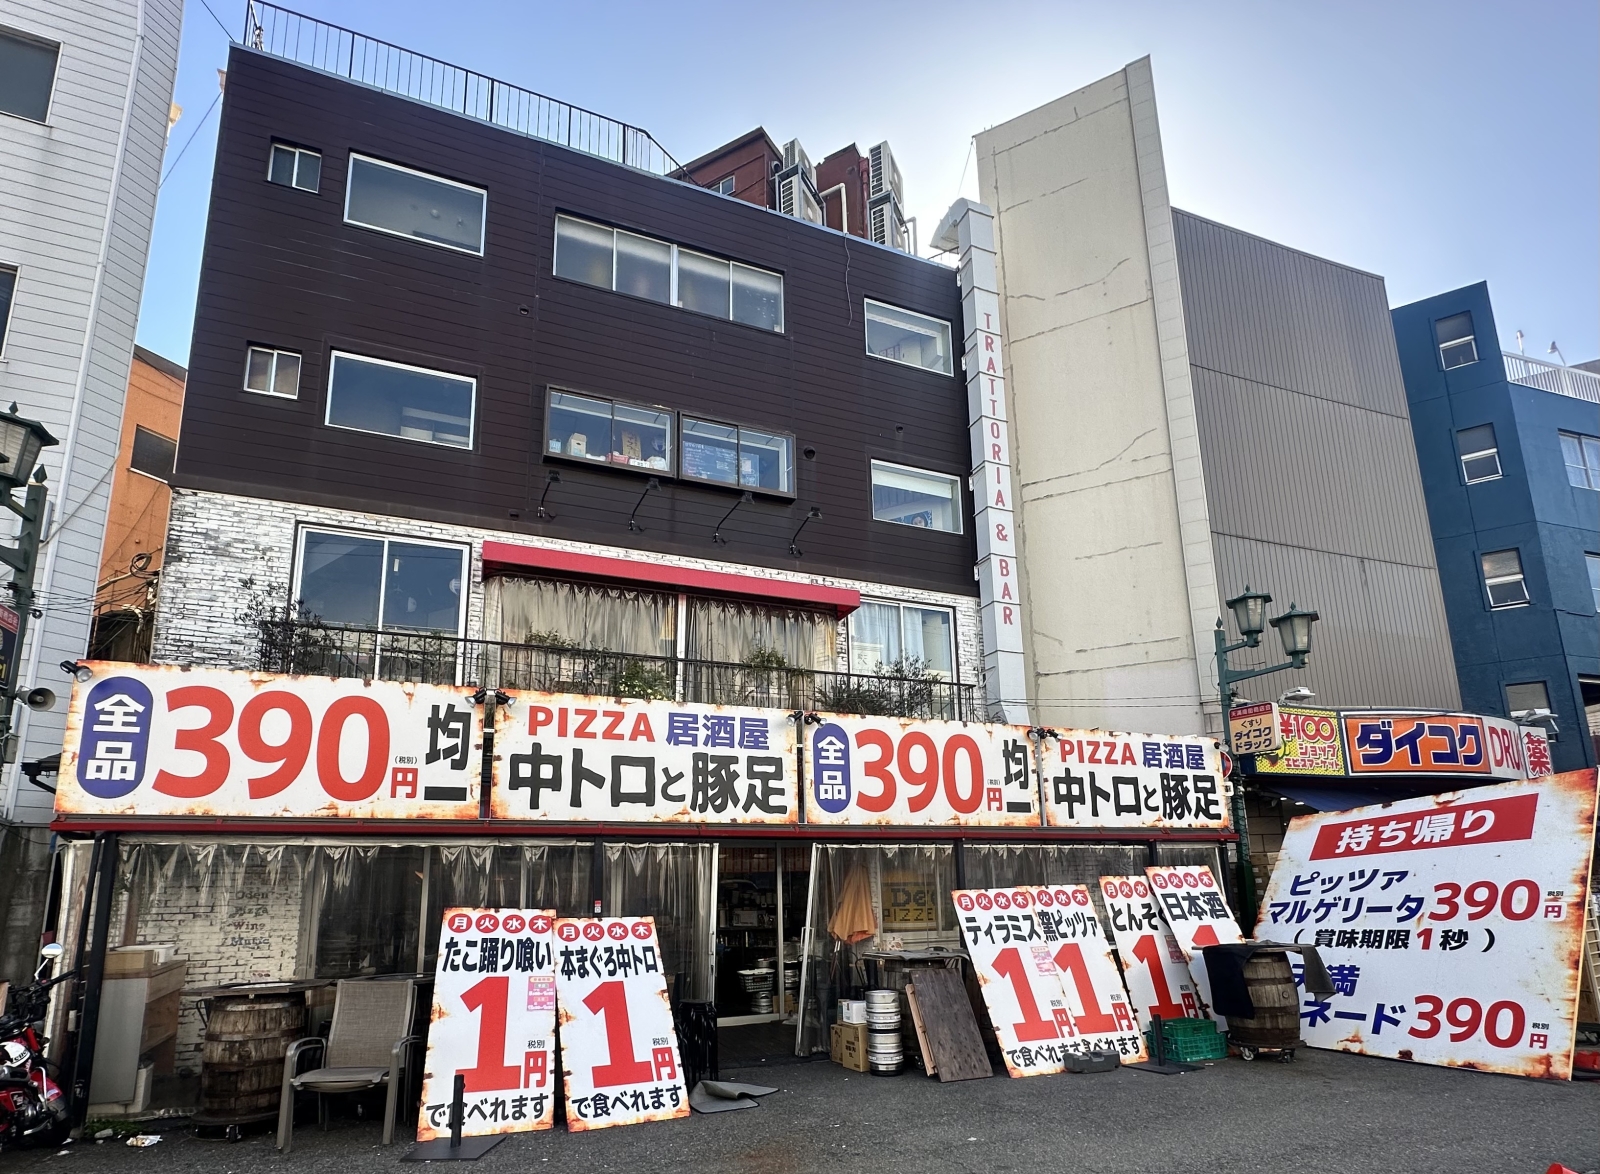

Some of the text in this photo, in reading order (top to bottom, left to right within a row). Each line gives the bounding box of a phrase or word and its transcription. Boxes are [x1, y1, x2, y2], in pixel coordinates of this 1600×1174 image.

[984, 313, 1013, 626] TRATTORIA & BAR
[86, 694, 146, 781] 全品
[528, 705, 770, 751] PIZZA 居酒屋
[1234, 727, 1272, 742] ダイコク
[1241, 718, 1262, 729] くすり
[1279, 713, 1335, 742] ¥100
[1060, 739, 1206, 771] PIZZA 居酒屋
[1235, 737, 1273, 752] ドラッグ
[1299, 743, 1337, 758] ショップ
[1355, 720, 1484, 767] ダイコク
[1488, 726, 1524, 771] DRU
[1526, 732, 1552, 774] 薬
[508, 742, 788, 815] 中トロと豚足
[817, 735, 847, 801] 全品
[1053, 767, 1222, 821] 中トロと豚足
[1335, 809, 1496, 854] 持ち帰り
[1289, 869, 1409, 897] ピッツァ
[1160, 891, 1231, 922] 日本酒
[1268, 894, 1426, 925] マルゲリータ
[964, 914, 1042, 946] ティラミス
[442, 936, 552, 974] たこ踊り喰い
[560, 944, 658, 982] 本まぐろ中トロ
[571, 1084, 683, 1120] で食べれます
